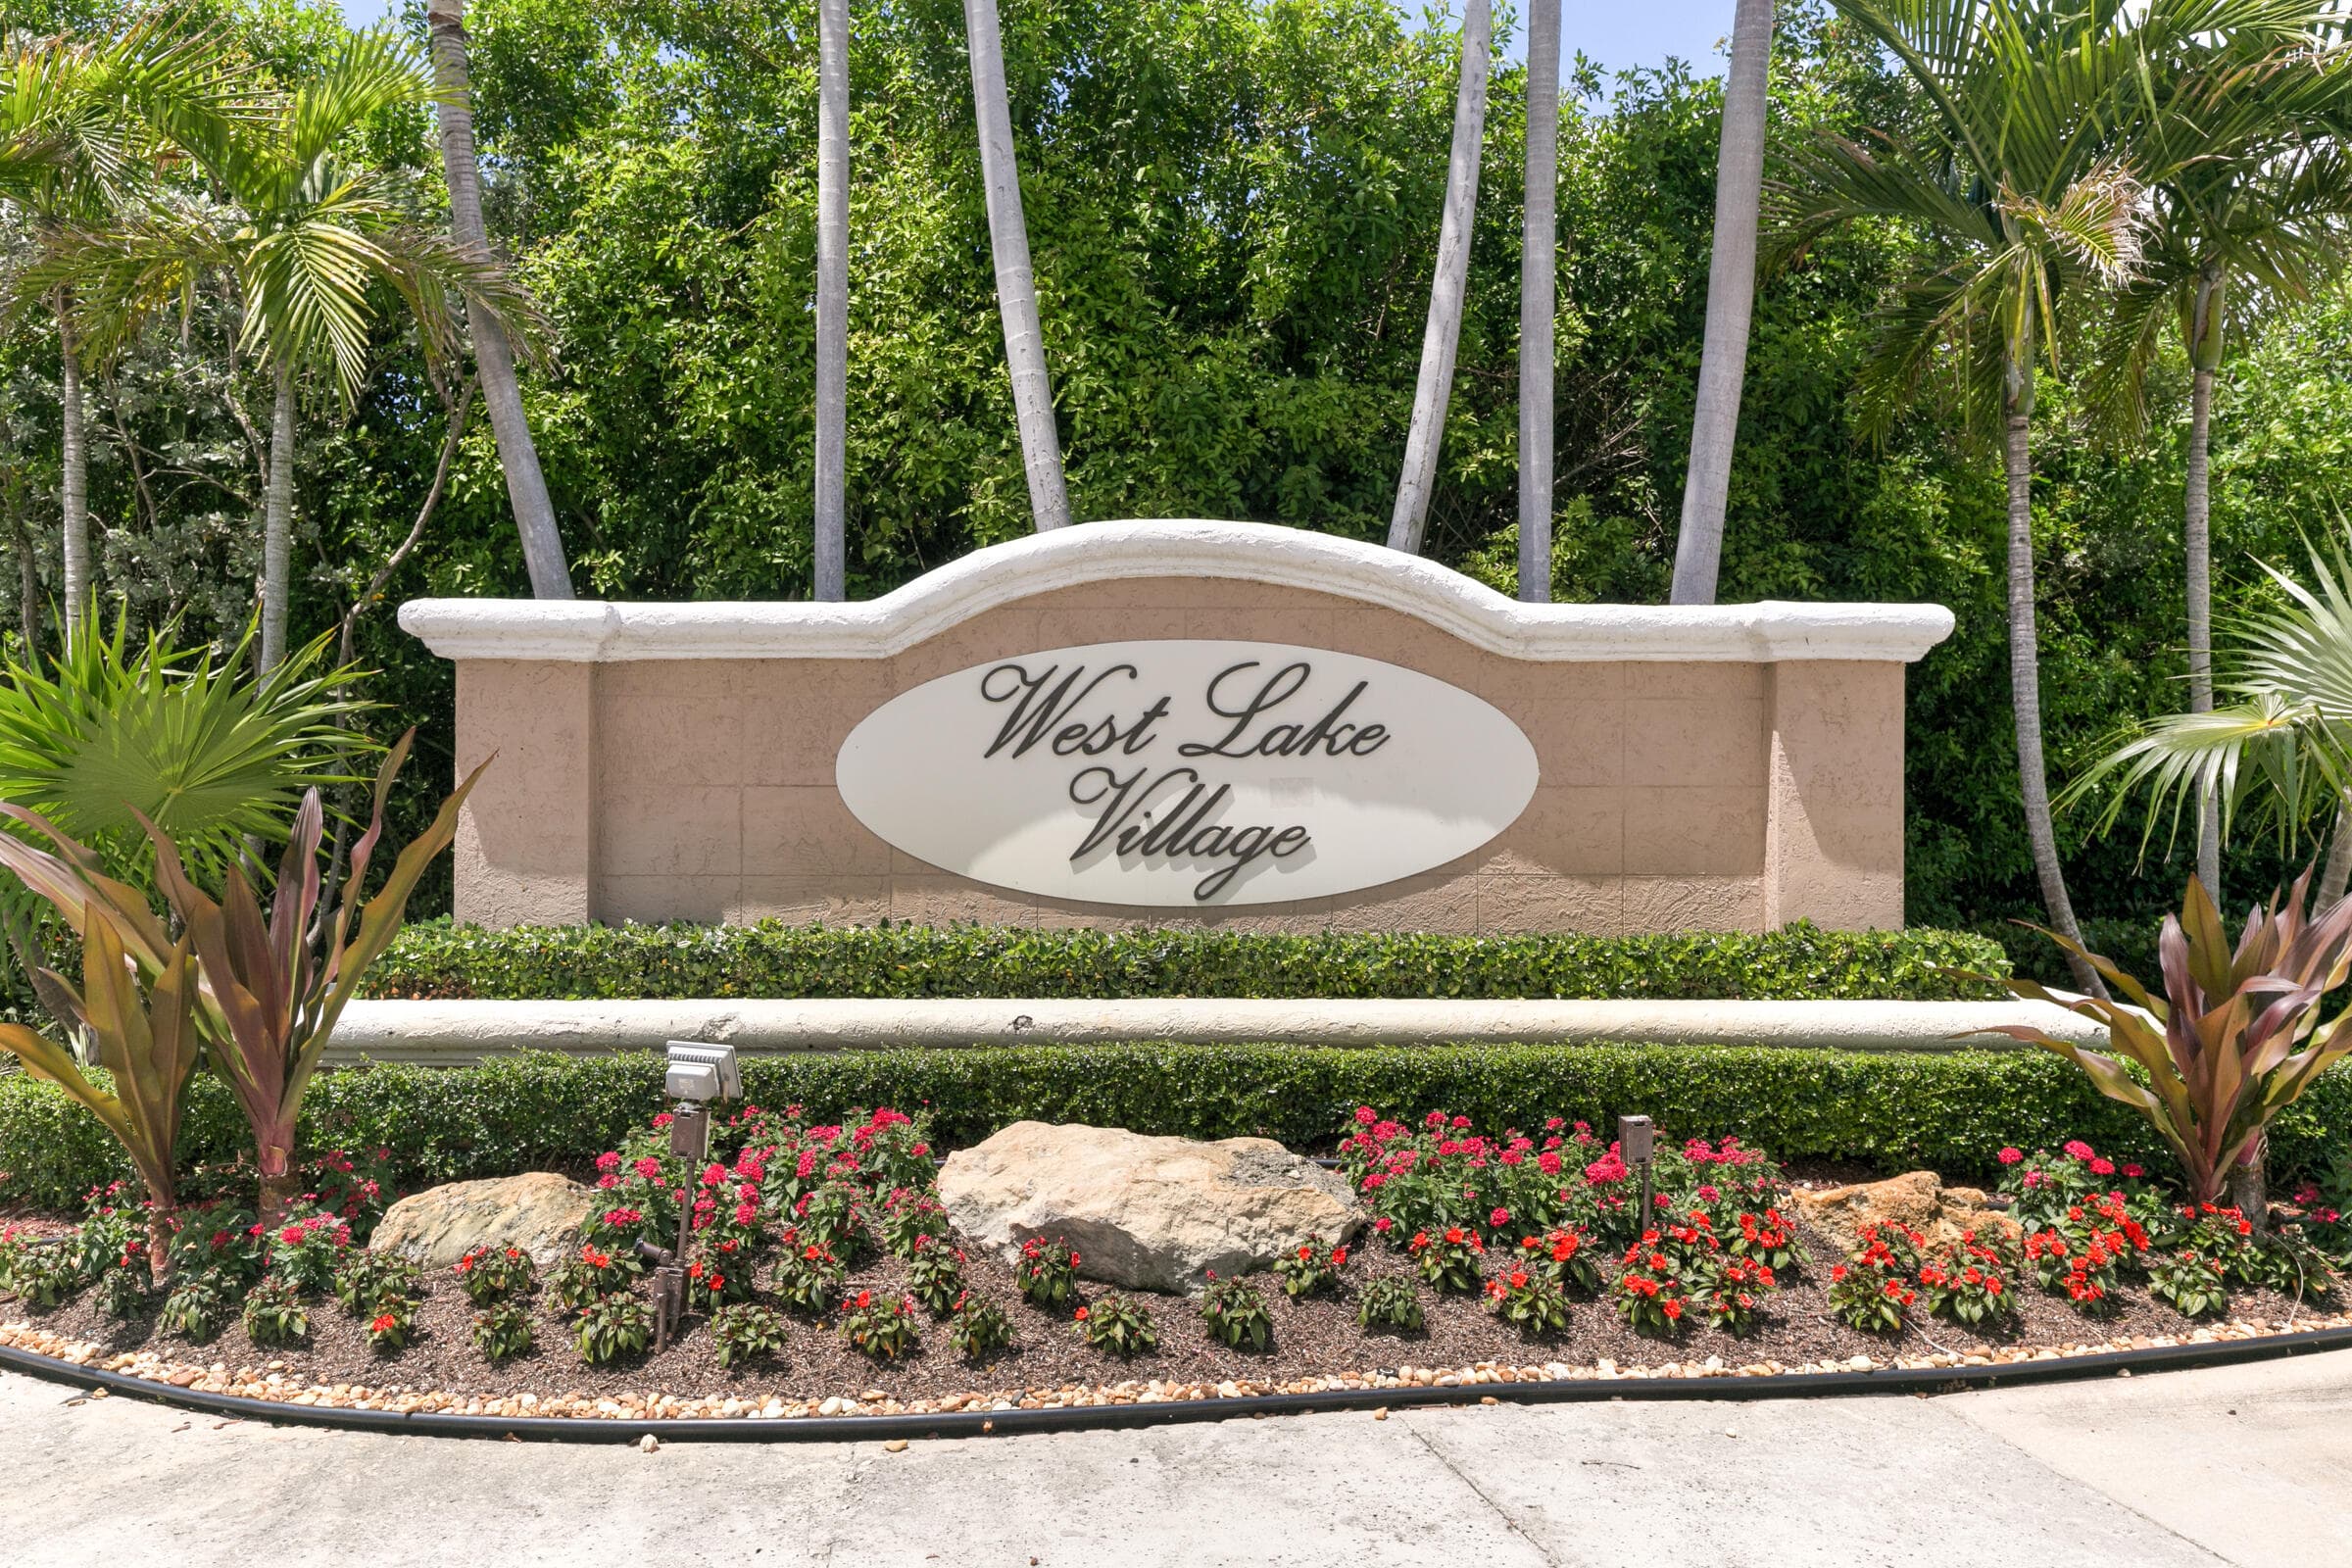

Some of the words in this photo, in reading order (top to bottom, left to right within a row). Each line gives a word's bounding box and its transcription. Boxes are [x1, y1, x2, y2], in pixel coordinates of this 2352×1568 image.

[980, 663, 1172, 759] West
[1177, 662, 1392, 759] Lake
[1068, 766, 1311, 901] Village
